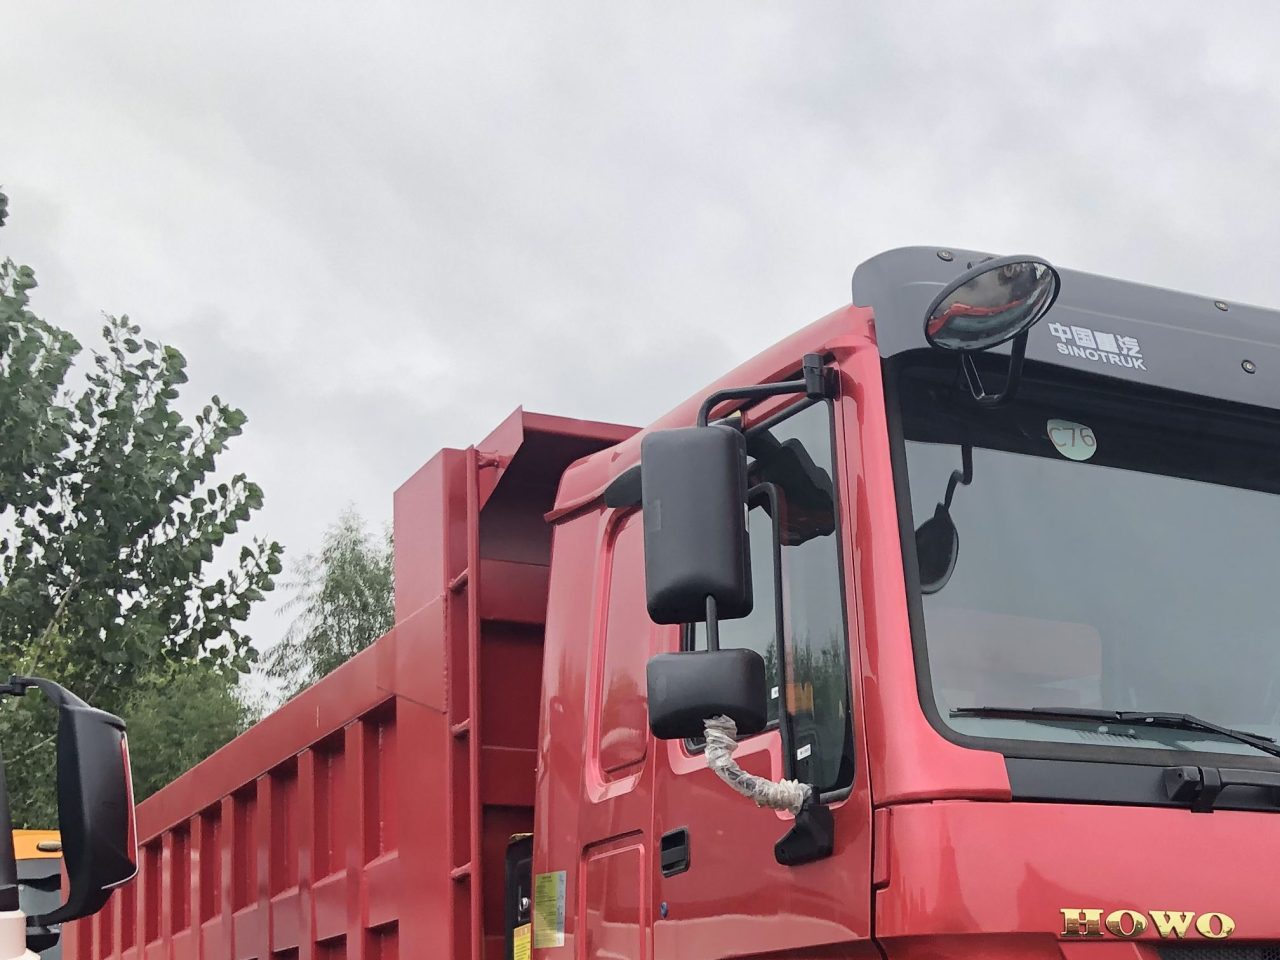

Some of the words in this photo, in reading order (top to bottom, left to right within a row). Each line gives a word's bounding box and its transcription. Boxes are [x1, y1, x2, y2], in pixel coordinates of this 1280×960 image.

[1048, 322, 1143, 358] 中国重汽
[1056, 342, 1147, 371] SINOTRUK
[1049, 427, 1096, 448] C76
[1059, 908, 1236, 939] HOWO
